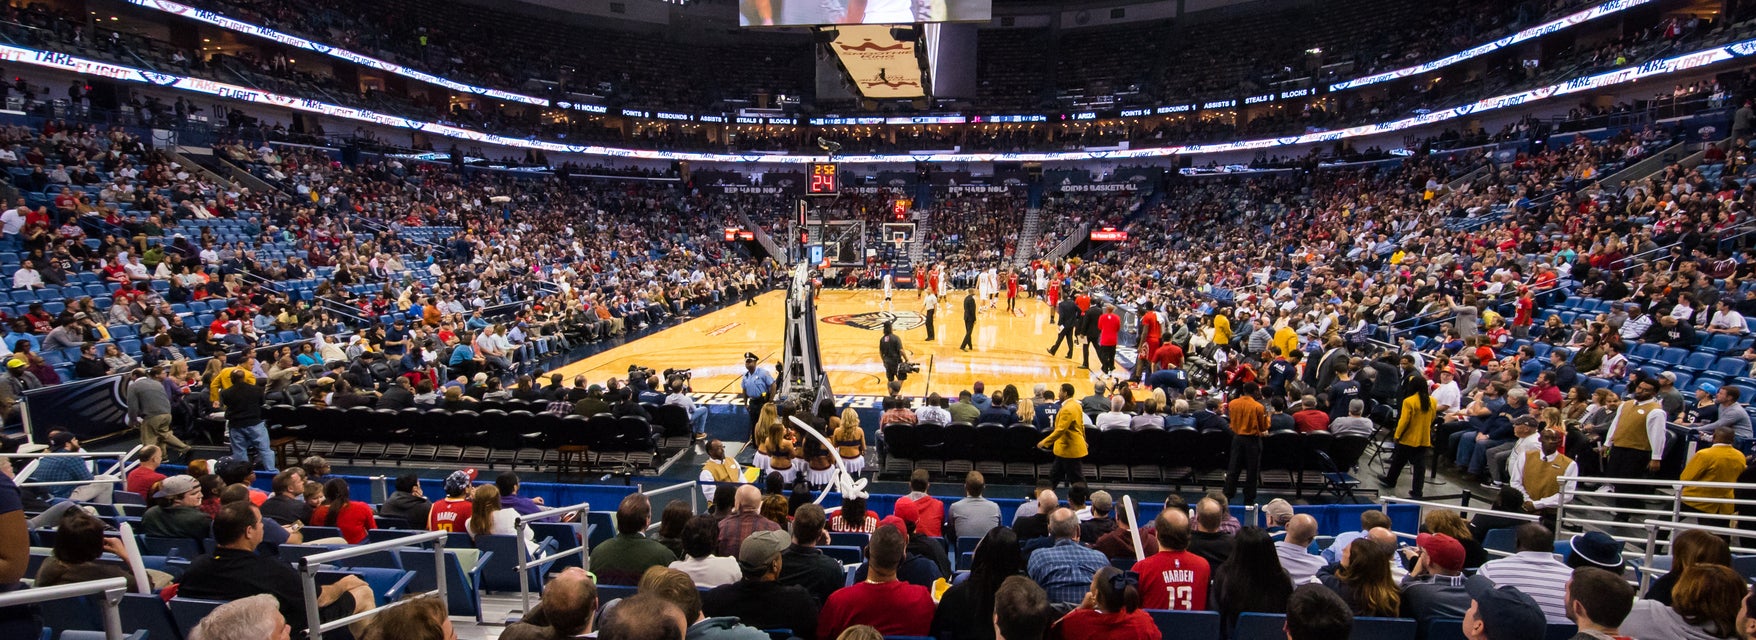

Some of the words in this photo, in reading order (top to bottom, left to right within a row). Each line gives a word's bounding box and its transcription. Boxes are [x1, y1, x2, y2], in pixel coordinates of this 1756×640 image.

[1598, 1, 1622, 13] TAKE
[194, 8, 219, 22] TAKE
[219, 18, 253, 33] FLIGHT
[1535, 22, 1563, 37] FLIGHT
[256, 26, 277, 38] TAKE
[277, 34, 305, 48] FLIGHT
[35, 50, 75, 67] TAKE
[75, 61, 131, 79] FLIGHT
[1636, 58, 1668, 75] TAKE
[1666, 51, 1717, 73] FLIGHT
[1566, 75, 1592, 90] TAKE
[1590, 71, 1631, 88] FLIGHT
[187, 78, 219, 92] TAKE
[218, 87, 258, 102] FLIGHT
[1281, 89, 1308, 99] BLOCKS
[1203, 101, 1230, 109] ASSISTS
[1245, 96, 1268, 105] STEALS
[1497, 93, 1528, 108] FLIGHT
[212, 103, 229, 119] 101
[581, 104, 608, 113] HOLIDAY
[622, 109, 642, 117] POINTS
[1157, 104, 1189, 113] REBOUNDS
[657, 112, 687, 121] REBOUNDS
[700, 115, 722, 123] ASSISTS
[1077, 112, 1096, 120] ARIZA
[814, 165, 835, 175] 2:52
[812, 175, 833, 192] 24
[1089, 183, 1138, 192] BASKETBALL
[437, 511, 458, 521] HARDEN
[1162, 569, 1194, 584] HARDEN
[1166, 585, 1193, 611] 13
